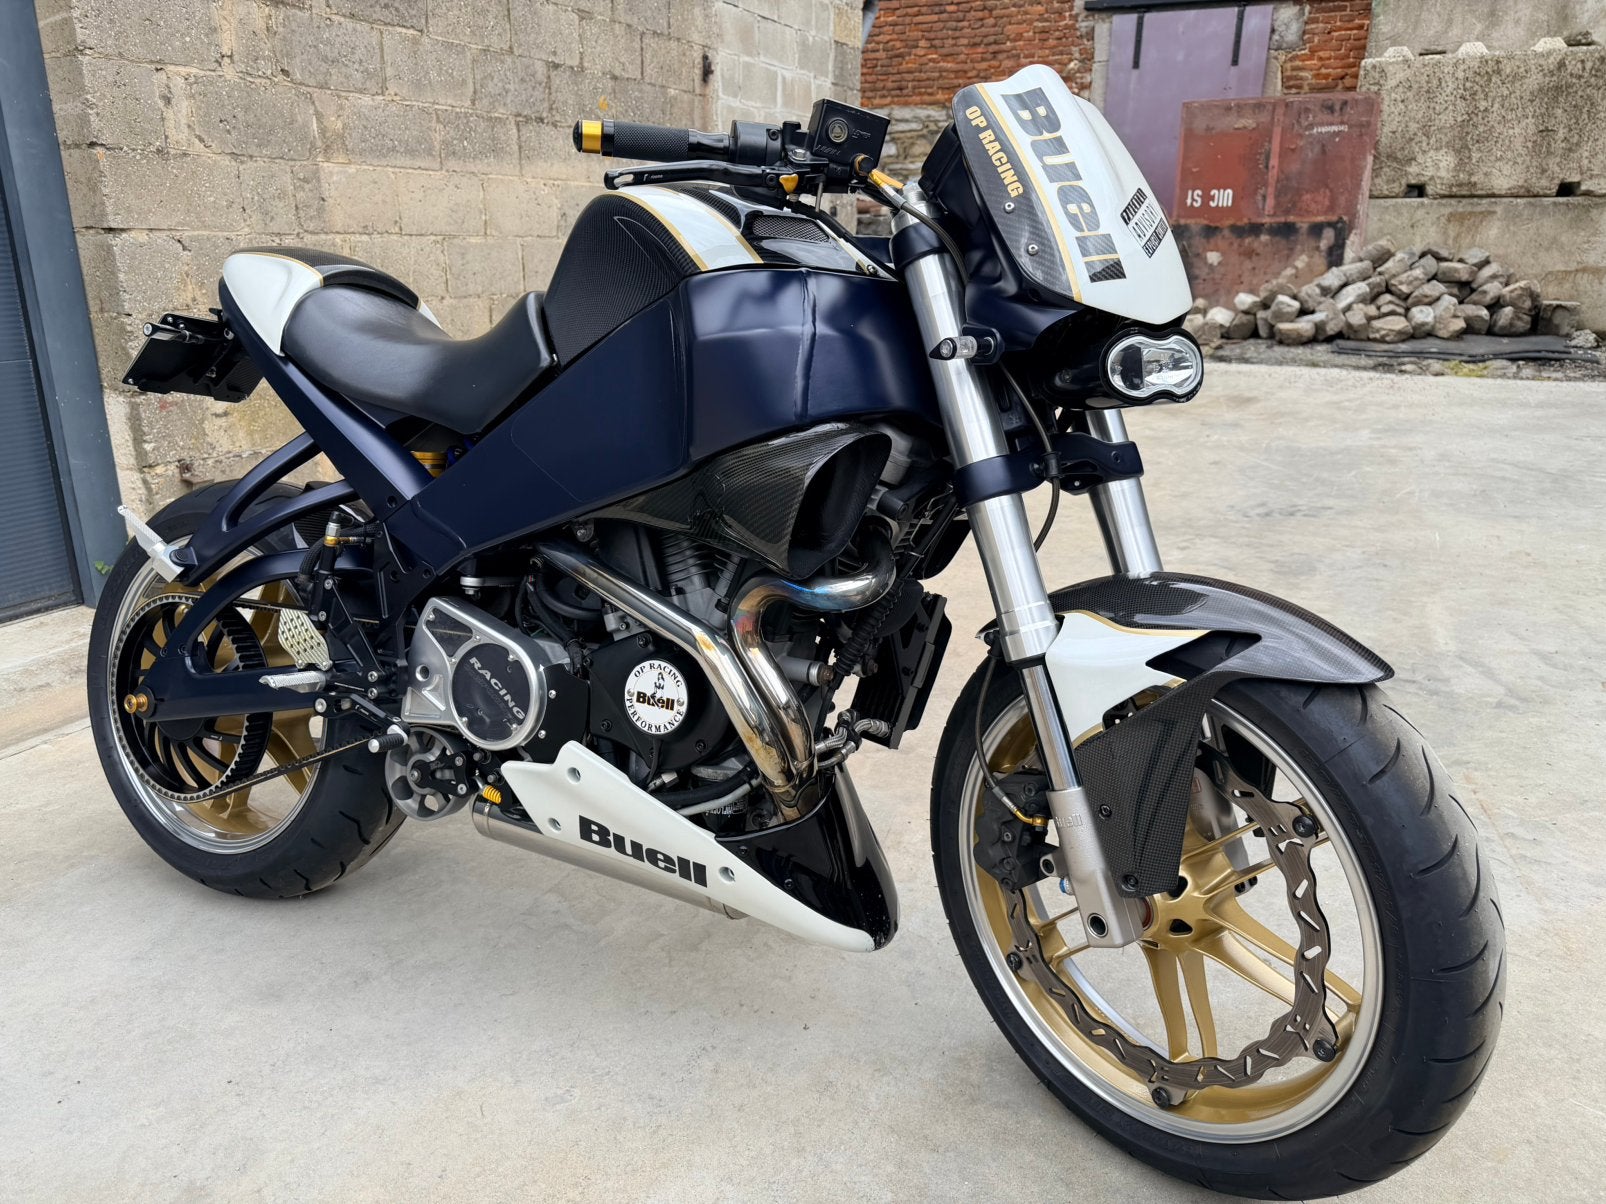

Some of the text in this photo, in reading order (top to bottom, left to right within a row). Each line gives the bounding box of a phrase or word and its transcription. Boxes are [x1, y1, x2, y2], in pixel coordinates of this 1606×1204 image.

[965, 105, 1024, 198] OP RACING
[1000, 87, 1126, 283] Buell
[1209, 188, 1233, 207] UIC
[469, 657, 525, 719] RACING
[634, 662, 683, 687] OP RACING
[626, 698, 684, 733] PERFORMANCE
[636, 691, 675, 711] Buell
[578, 814, 708, 888] Buell
